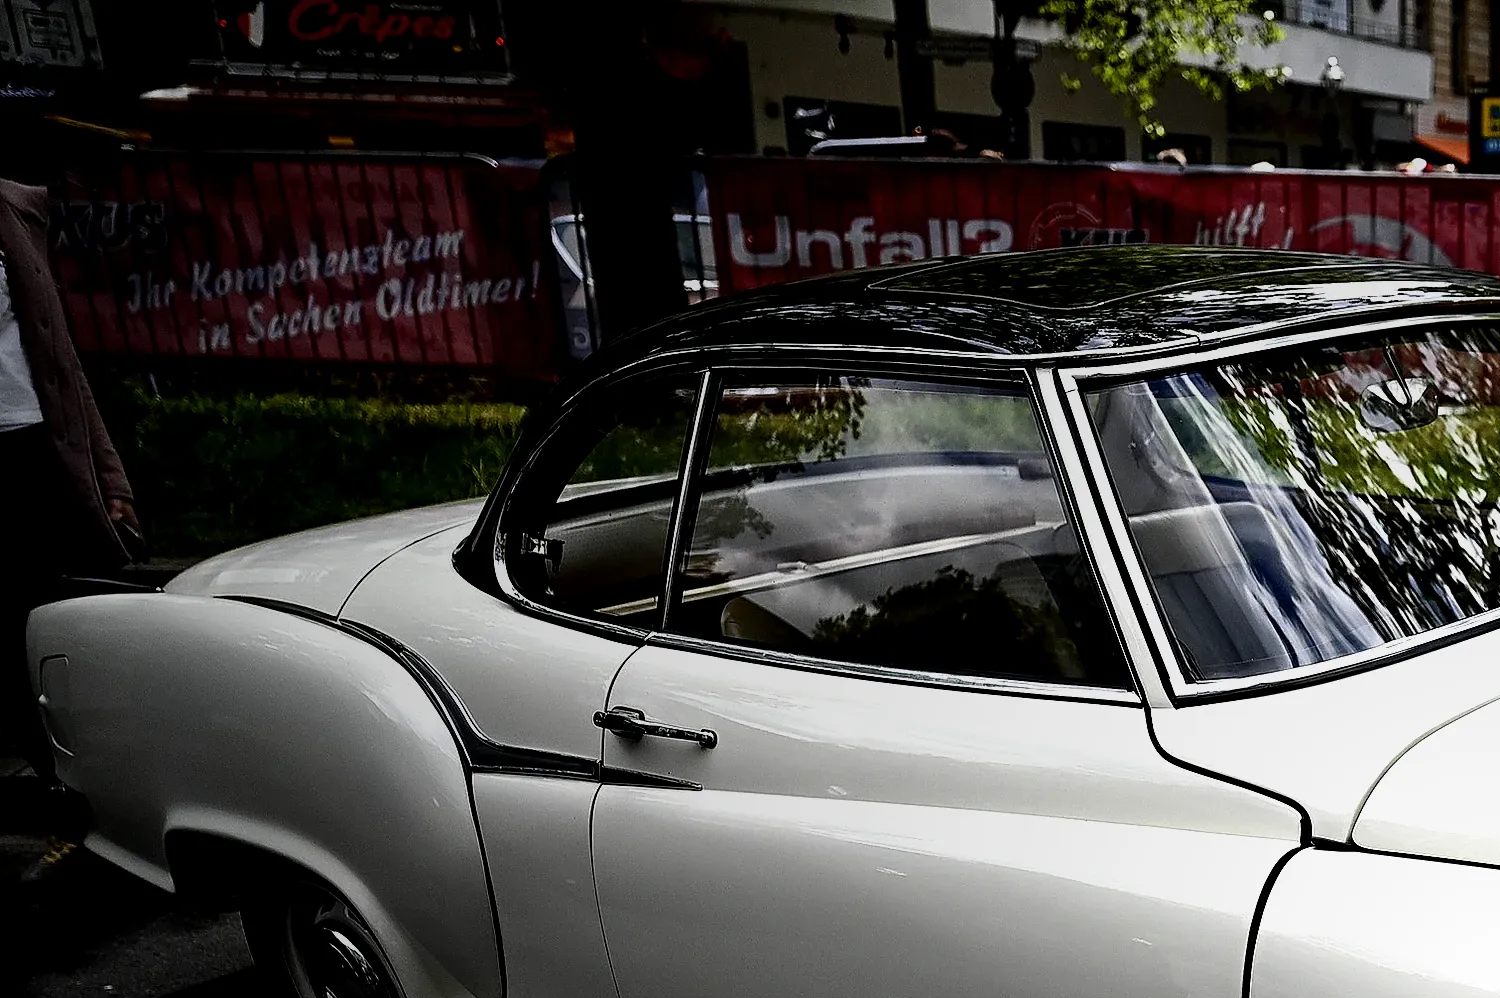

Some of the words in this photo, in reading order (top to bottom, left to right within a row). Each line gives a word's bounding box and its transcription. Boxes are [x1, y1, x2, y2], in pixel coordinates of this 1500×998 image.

[126, 271, 176, 315] Ihr
[190, 228, 465, 302] Kompetenzteam
[199, 316, 231, 353] in
[246, 294, 364, 345] Sachen
[375, 258, 541, 322] Oldtimer!
